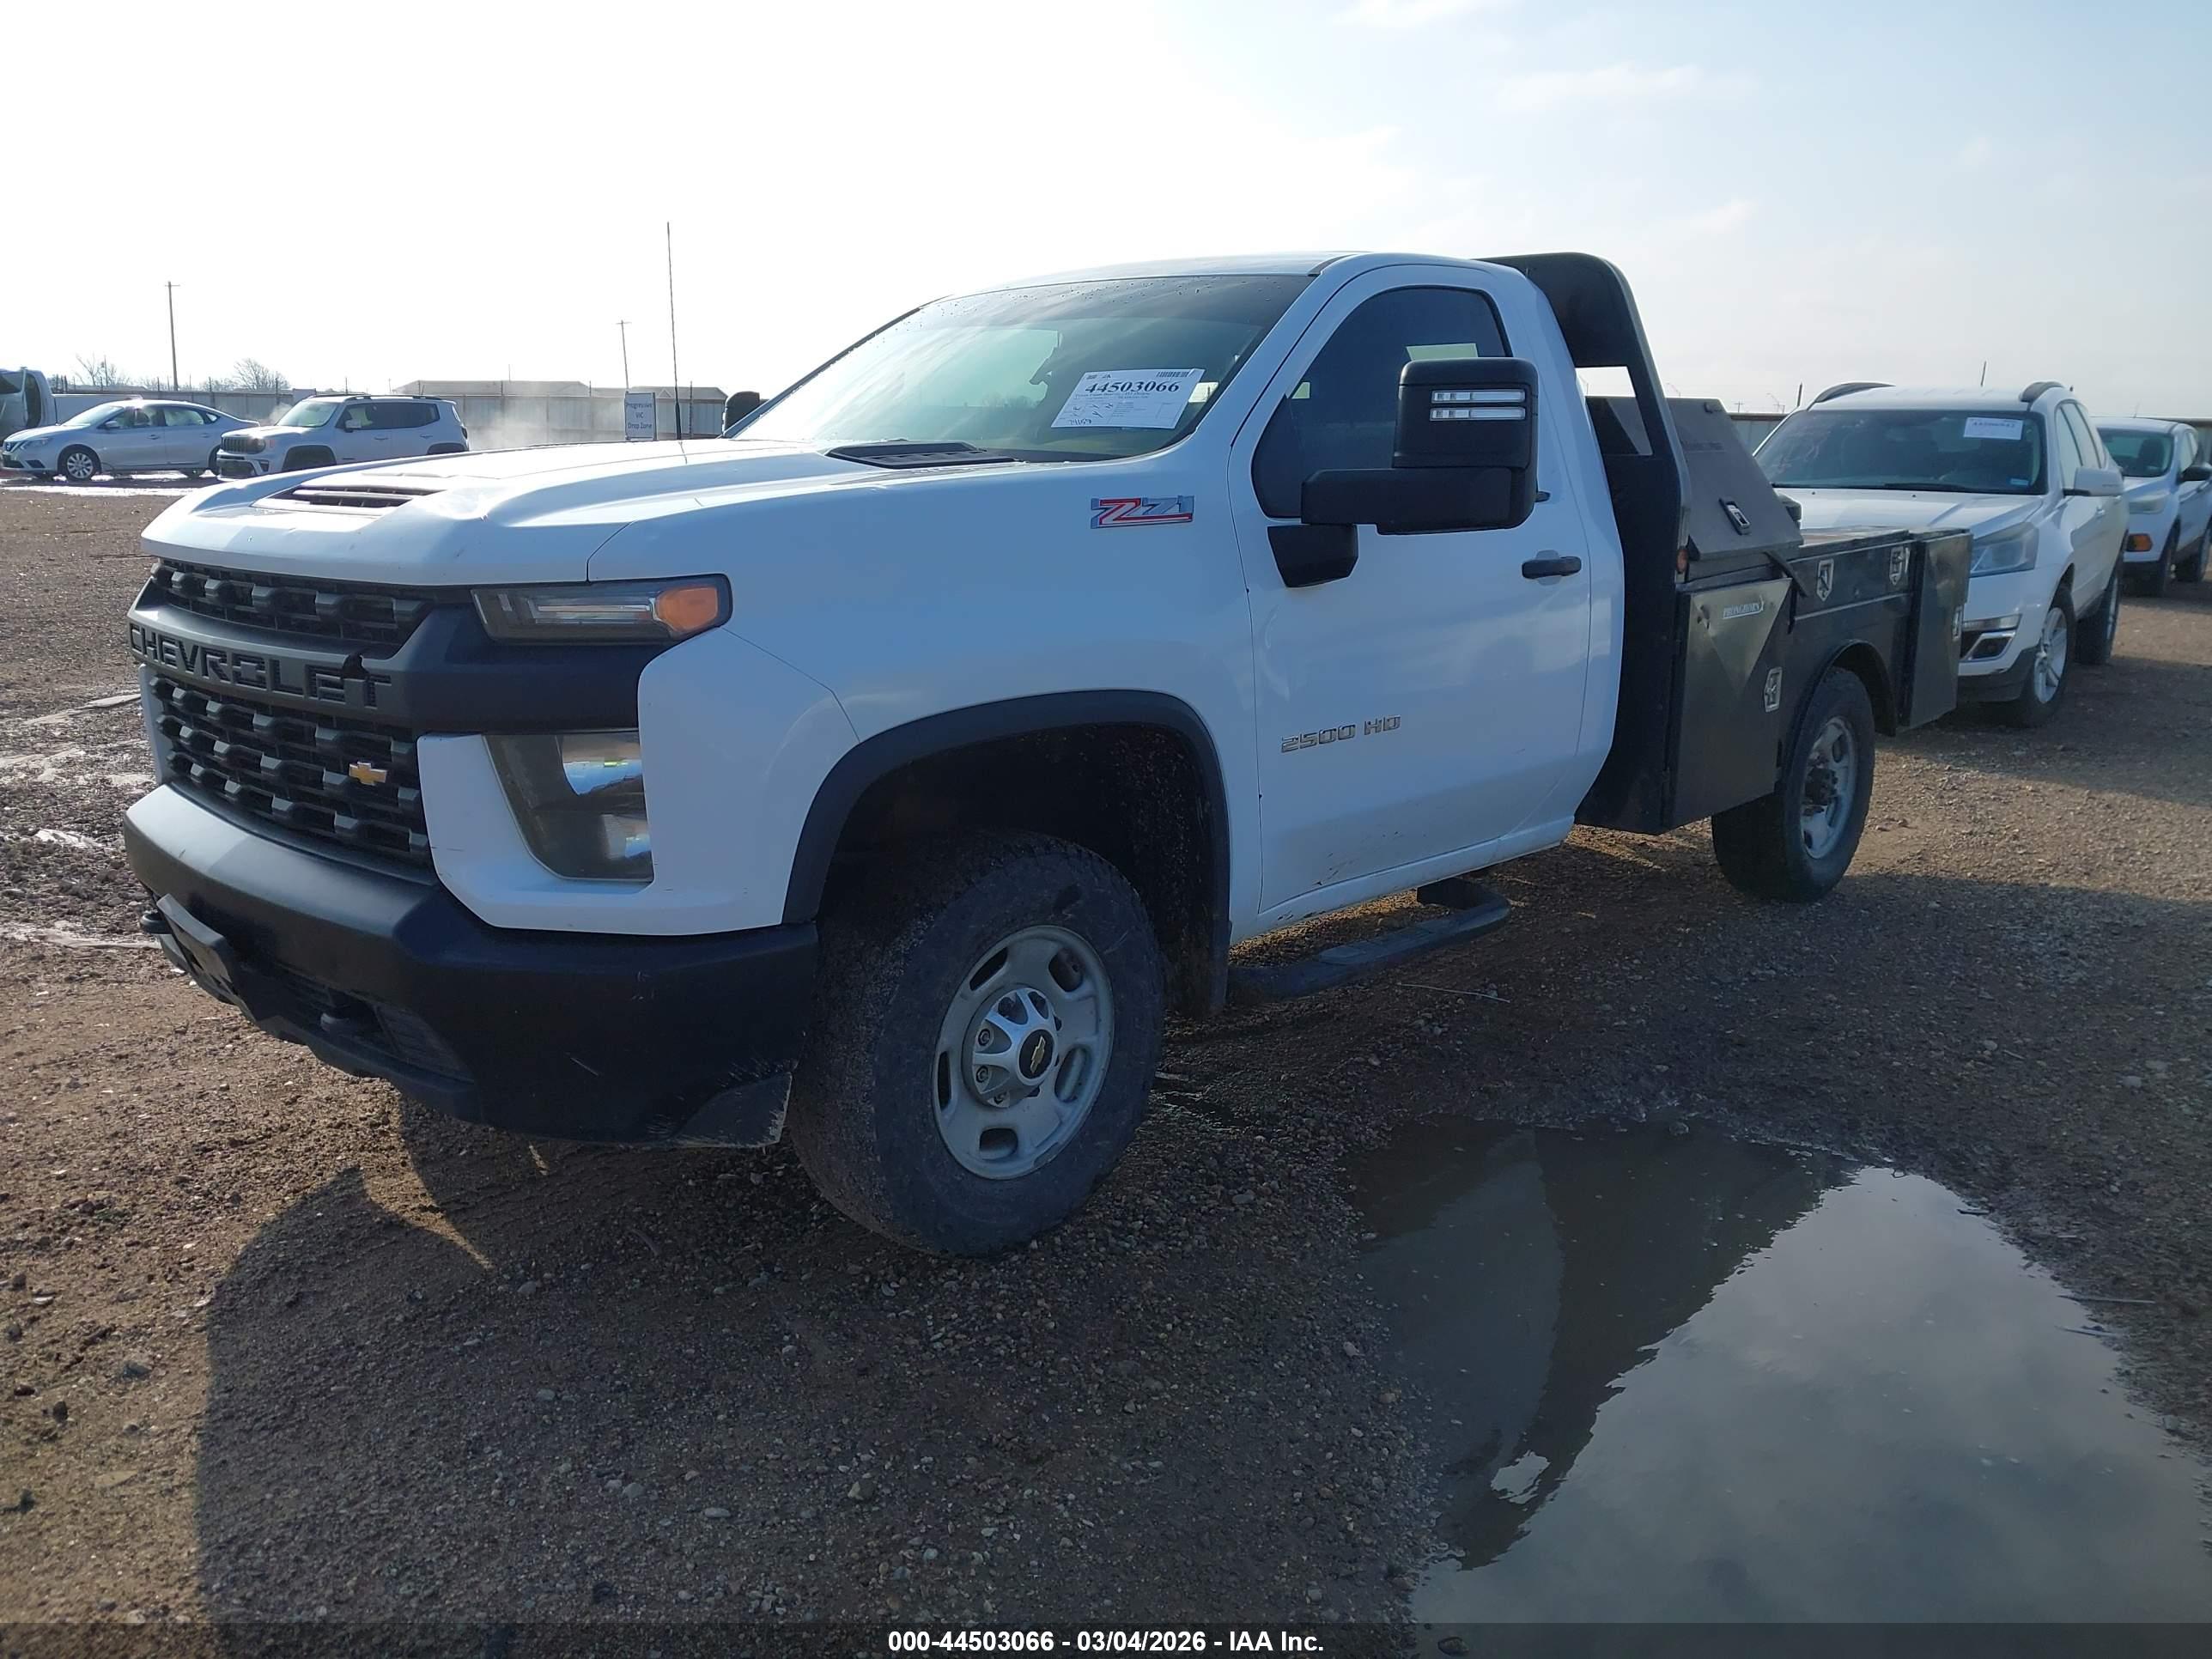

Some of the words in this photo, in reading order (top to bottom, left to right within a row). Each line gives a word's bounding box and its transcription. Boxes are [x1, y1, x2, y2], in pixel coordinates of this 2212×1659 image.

[1085, 380, 1182, 393] 44503066
[628, 422, 640, 430] Drop
[1091, 495, 1194, 529] Z71
[130, 623, 392, 709] CHEVROLET
[1281, 724, 1356, 753] 2500
[1364, 714, 1401, 736] HD
